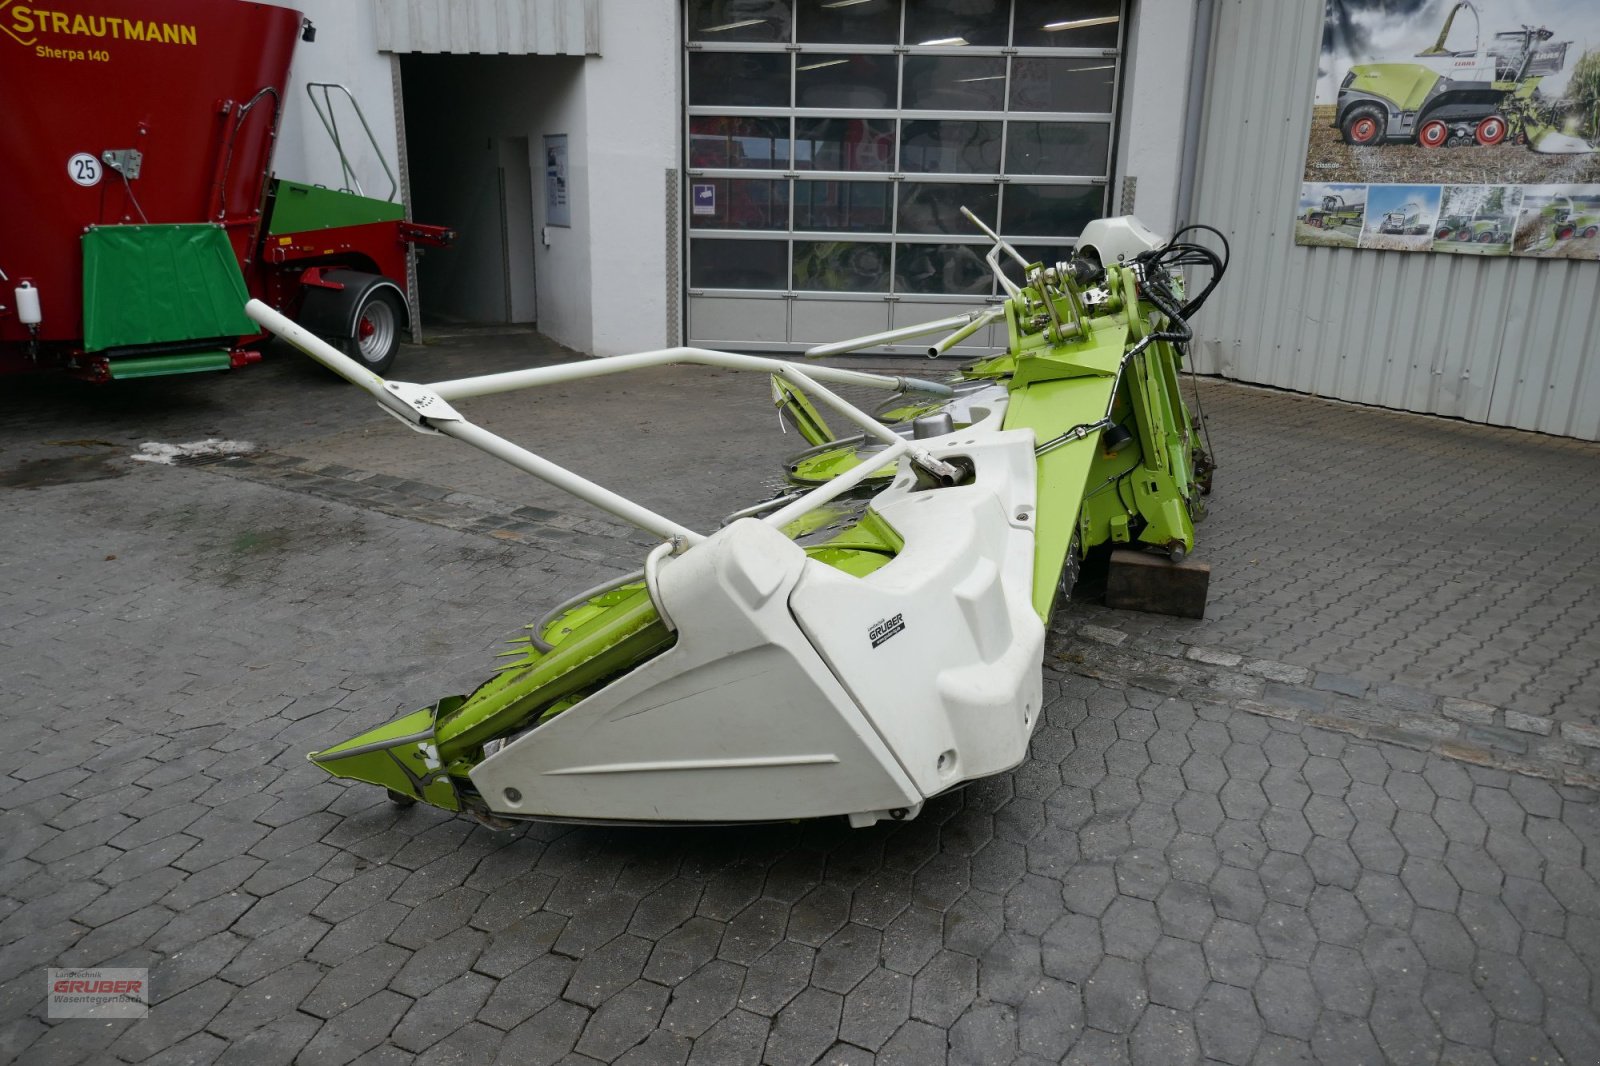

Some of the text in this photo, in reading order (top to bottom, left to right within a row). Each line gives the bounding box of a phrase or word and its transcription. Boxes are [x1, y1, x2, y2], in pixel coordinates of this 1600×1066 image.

[12, 5, 198, 46] STRAUTMANN
[36, 45, 110, 62] Sherpa 140
[75, 159, 95, 180] 25
[868, 612, 904, 641] GRUBER
